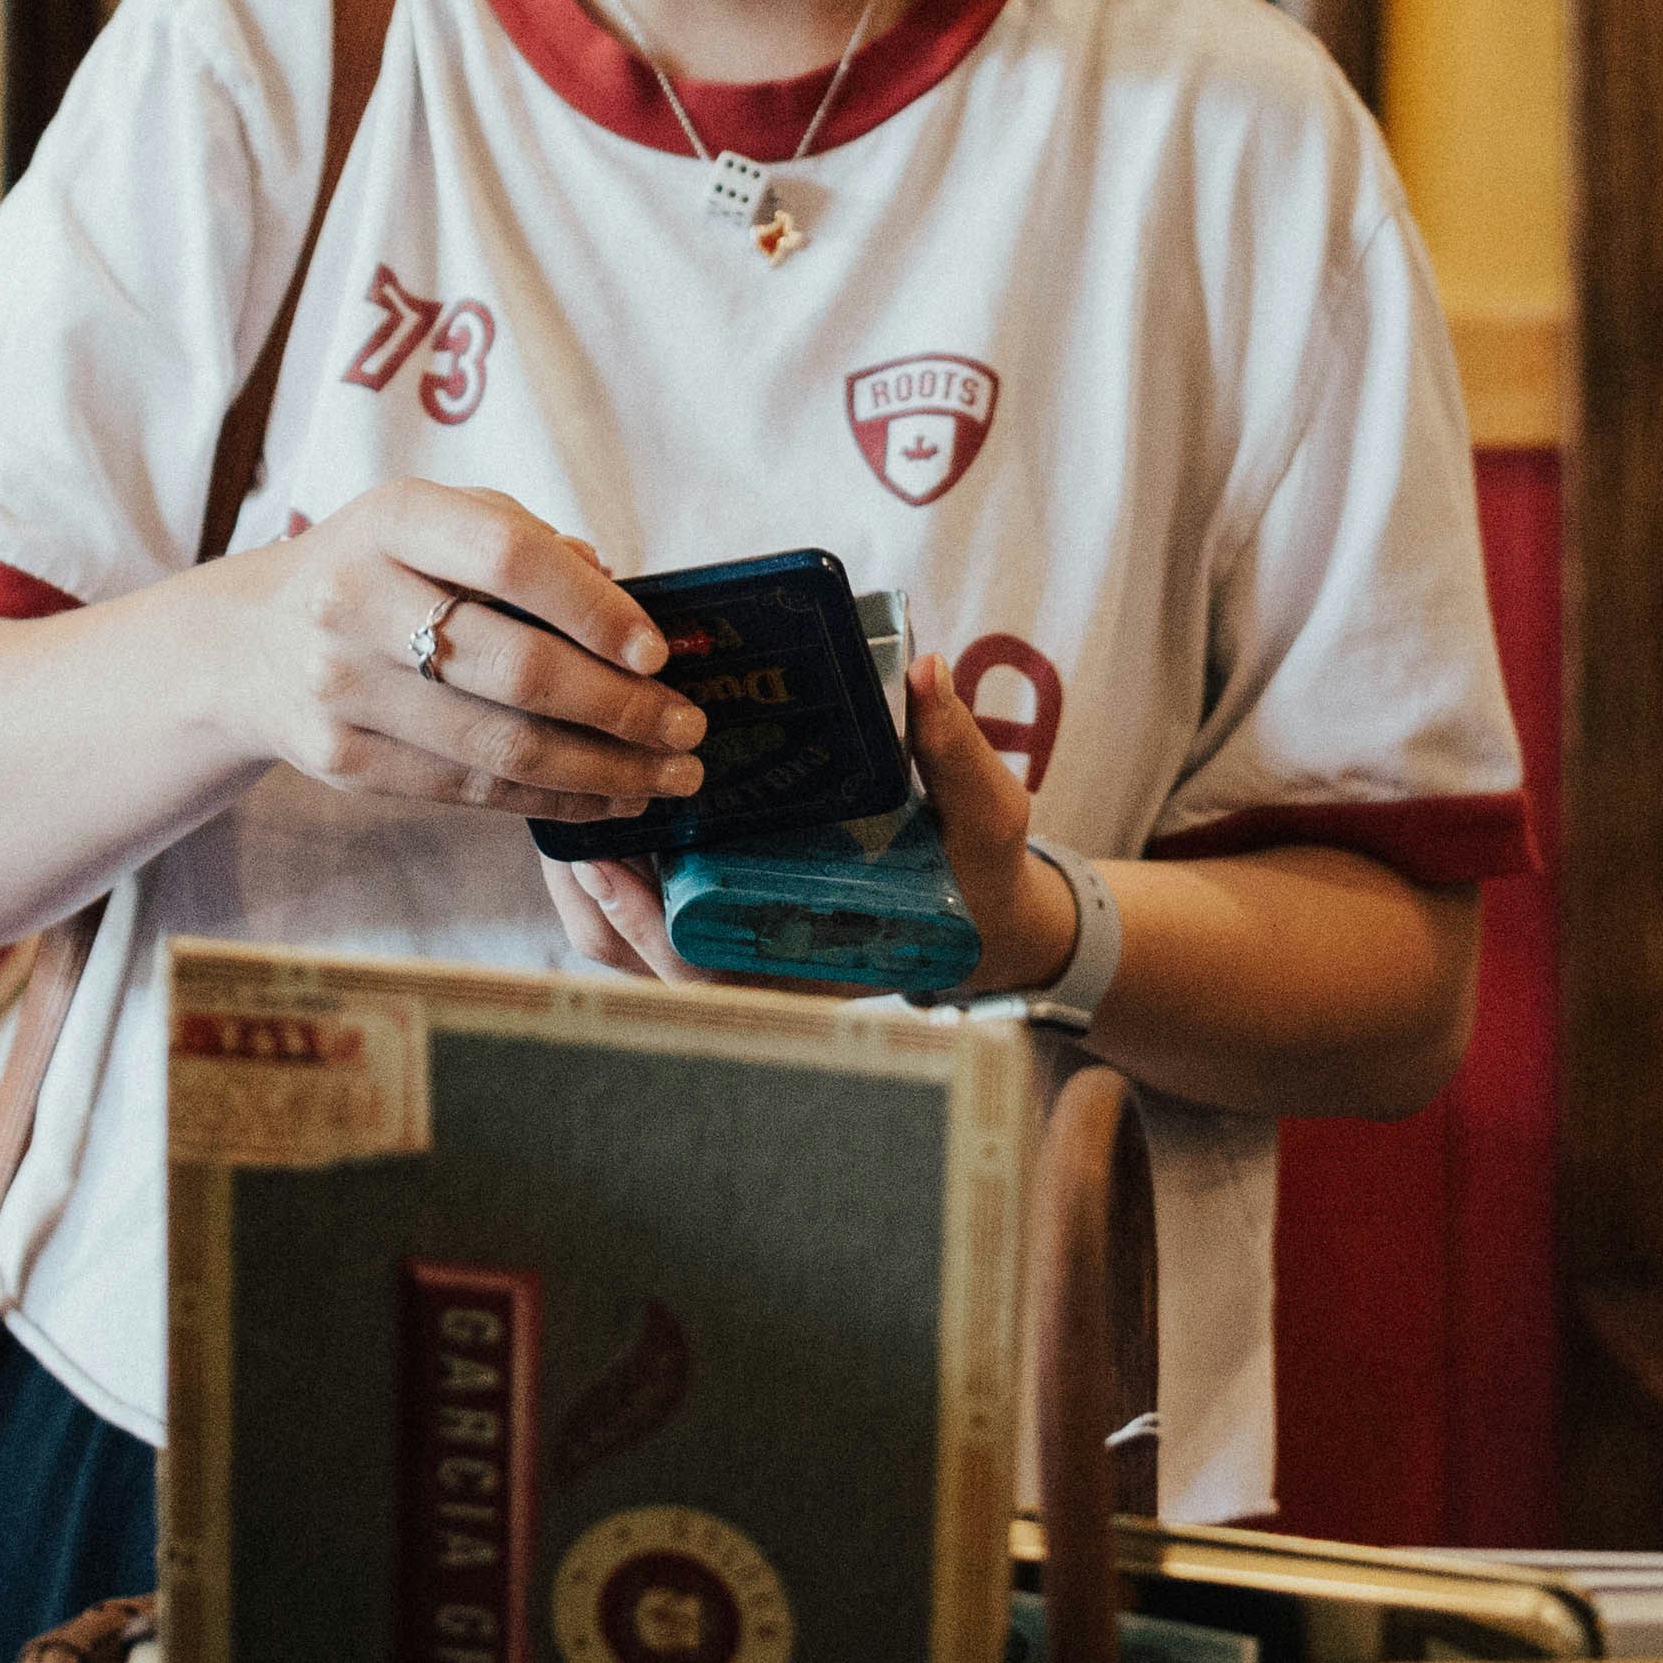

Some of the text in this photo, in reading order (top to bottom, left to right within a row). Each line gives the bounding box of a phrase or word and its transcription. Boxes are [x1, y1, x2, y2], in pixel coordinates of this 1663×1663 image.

[340, 262, 496, 425] 73
[870, 369, 980, 408] ROOTS
[435, 1305, 503, 1569] GARCIA
